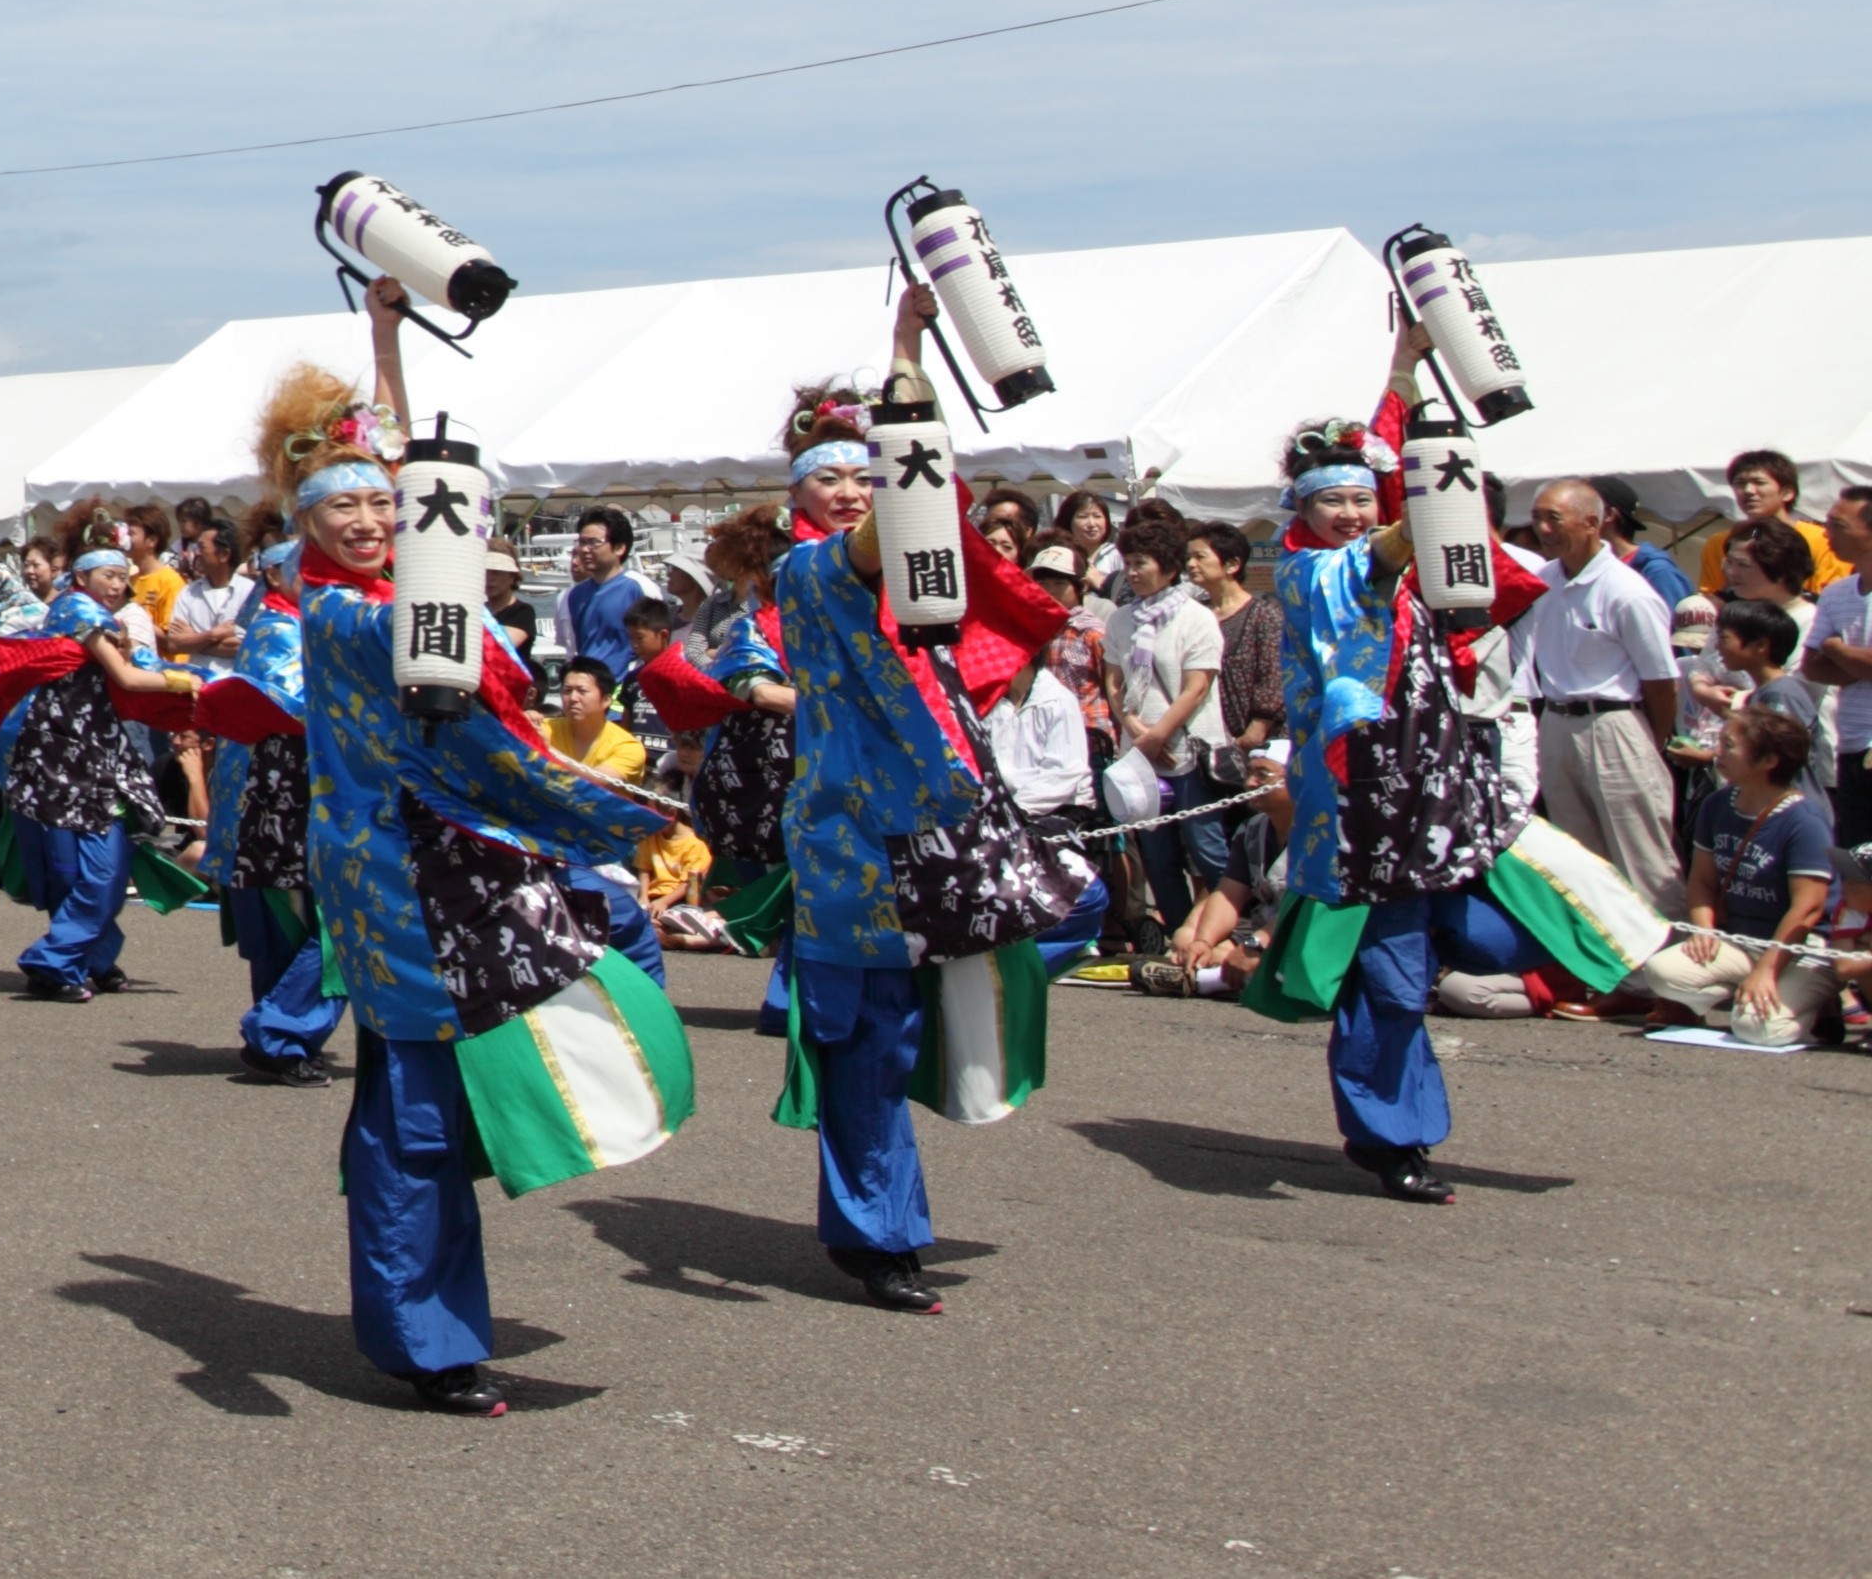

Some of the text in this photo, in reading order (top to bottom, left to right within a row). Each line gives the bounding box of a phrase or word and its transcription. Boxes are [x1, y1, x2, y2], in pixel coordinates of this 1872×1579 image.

[408, 478, 469, 664] 大間
[894, 440, 960, 602] 大間
[1434, 451, 1489, 588] 大間
